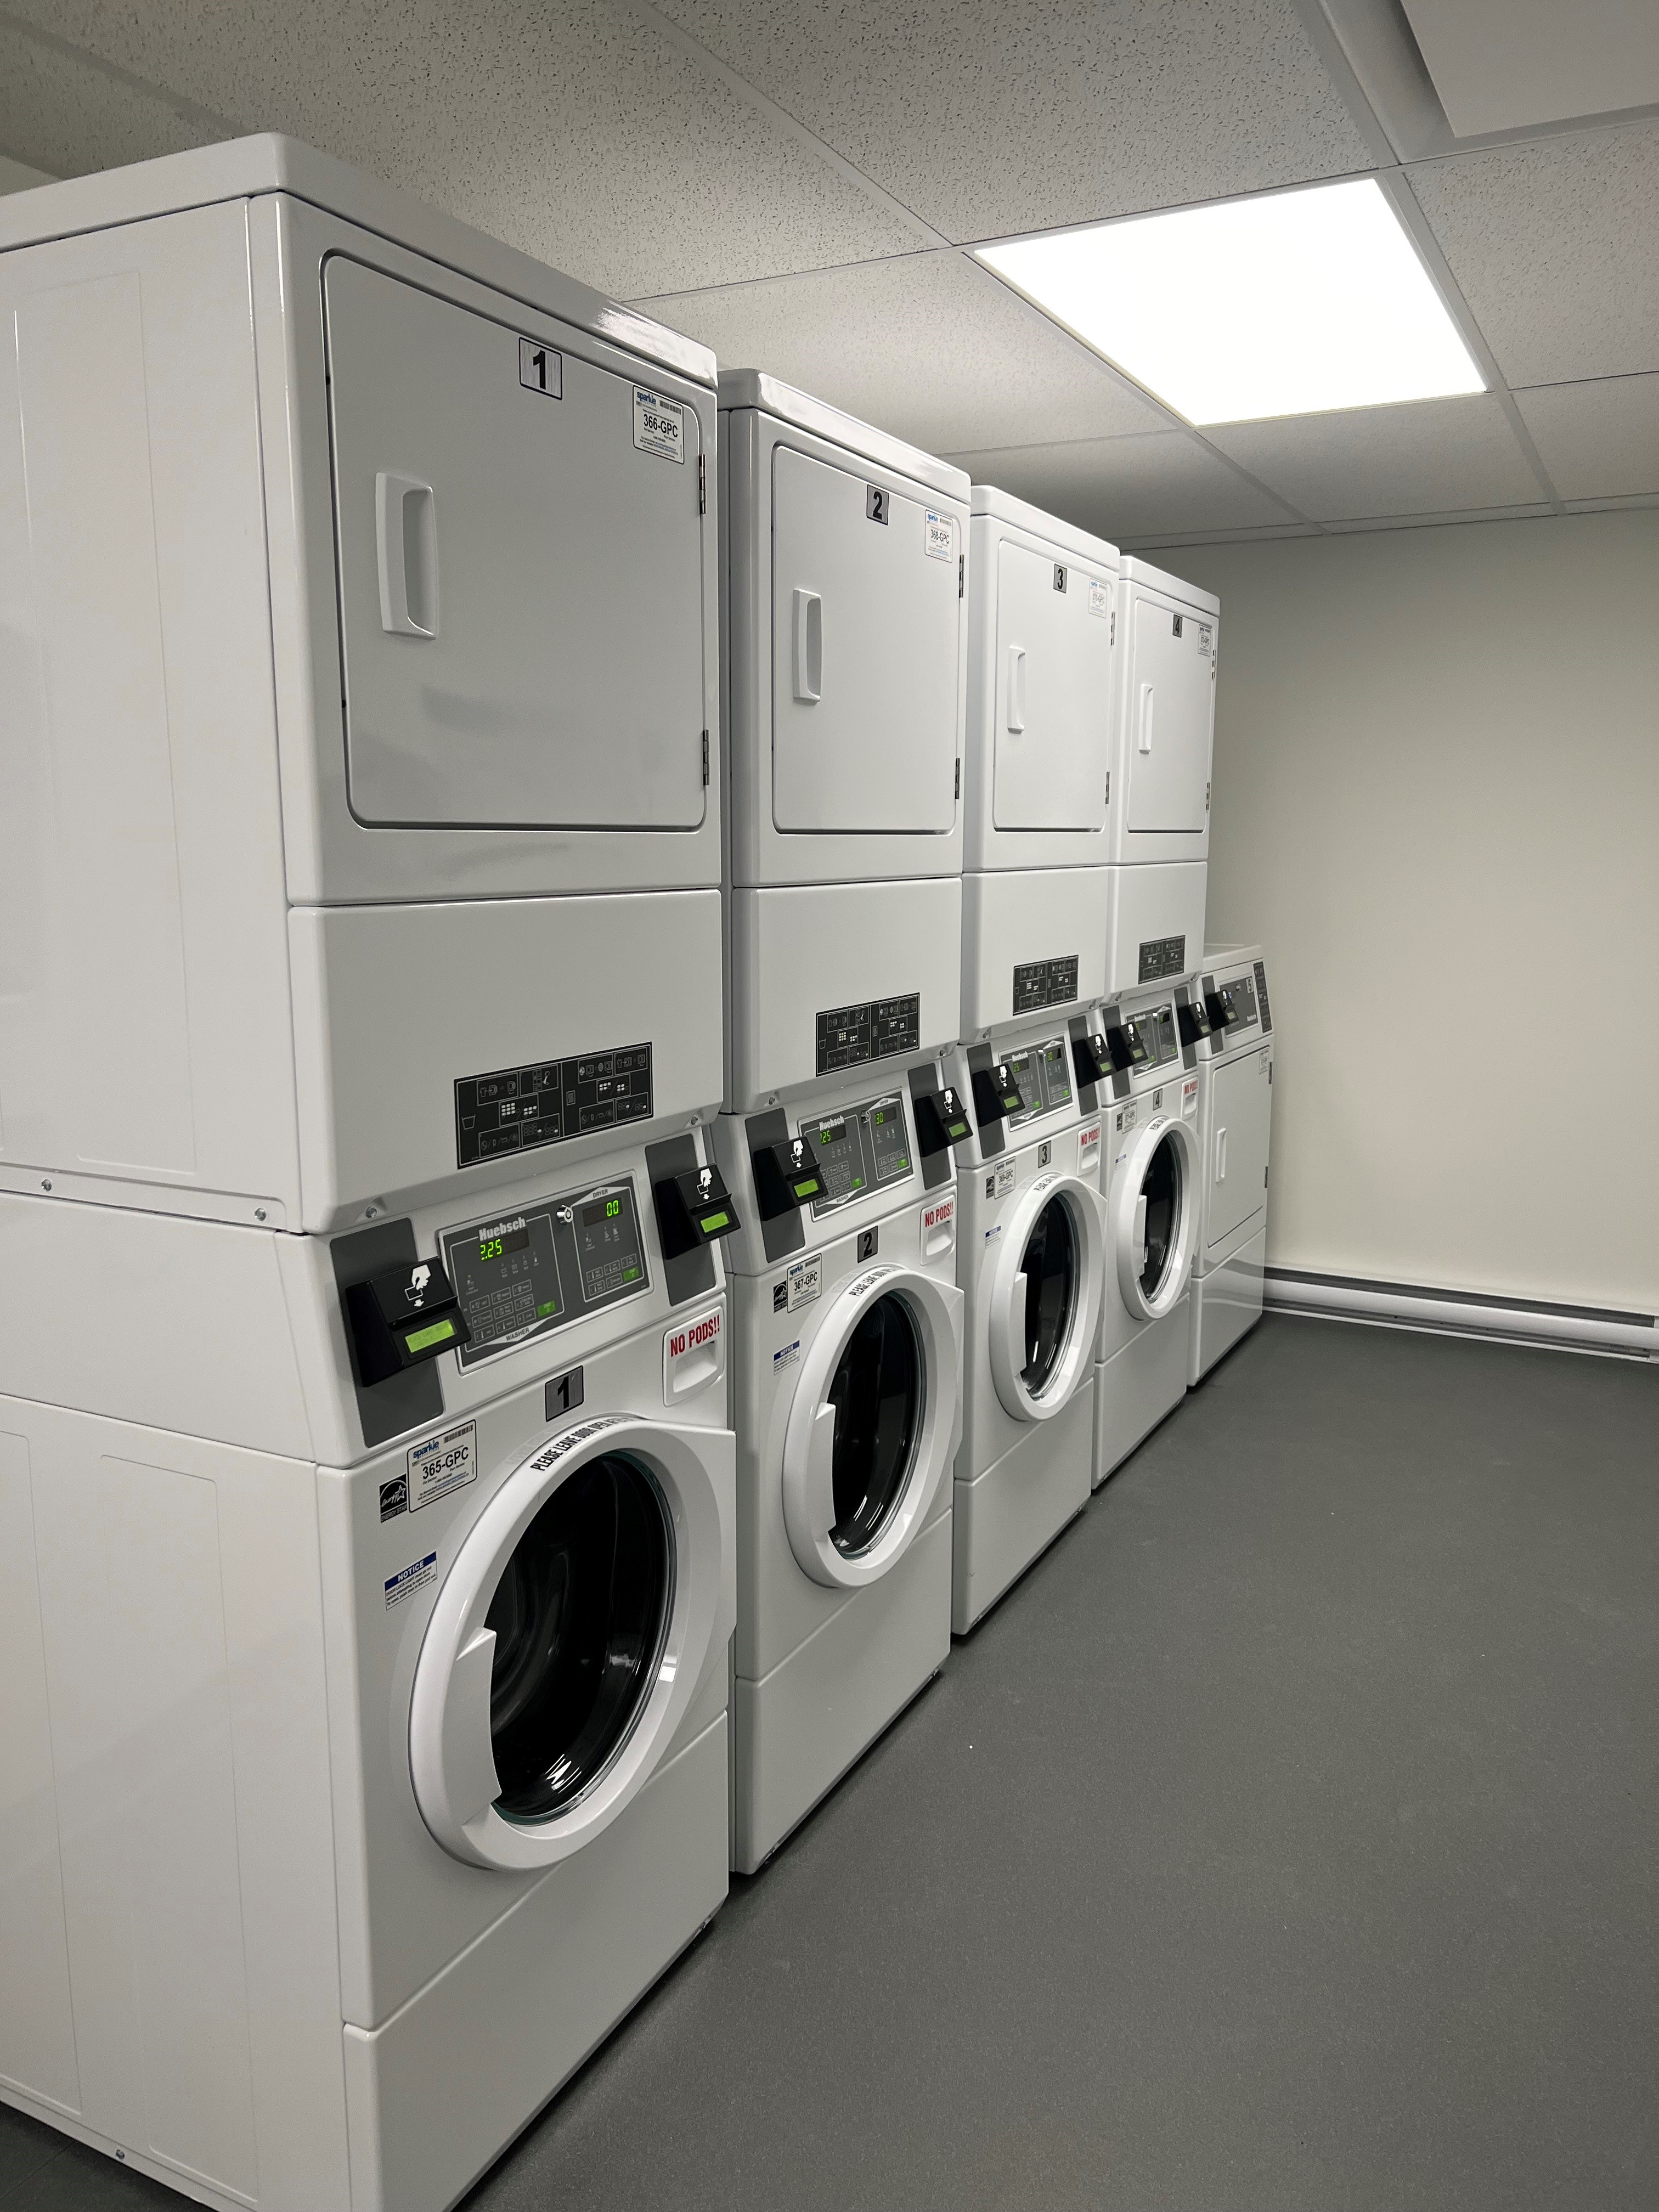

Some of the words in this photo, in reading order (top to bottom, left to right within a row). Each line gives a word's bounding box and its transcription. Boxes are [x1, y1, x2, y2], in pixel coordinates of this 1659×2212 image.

[533, 349, 546, 390] 1
[637, 391, 656, 405] sparkle
[644, 413, 678, 438] 366-GPC
[872, 491, 882, 520] 2
[1057, 568, 1063, 590] 3
[1175, 618, 1180, 635] 4
[1155, 1091, 1159, 1107] 4
[819, 1115, 845, 1131] Huebsch
[1042, 1145, 1047, 1164] 3
[592, 1189, 608, 1198] DRYER
[925, 1211, 934, 1227] NO
[936, 1201, 953, 1223] PODS!!
[478, 1216, 527, 1242] Huebsch
[864, 1232, 872, 1257] 2
[794, 1272, 817, 1291] 367-GPC
[506, 1327, 529, 1341] WASHER
[670, 1334, 685, 1357] NO
[689, 1314, 720, 1349] PODS!!
[557, 1375, 569, 1409] 1
[413, 1440, 439, 1459] sparkle
[530, 1448, 563, 1471] PLEASE
[552, 1436, 582, 1451] LEAVE
[422, 1446, 469, 1480] 365-GPC
[398, 1560, 424, 1582] NOTICE
